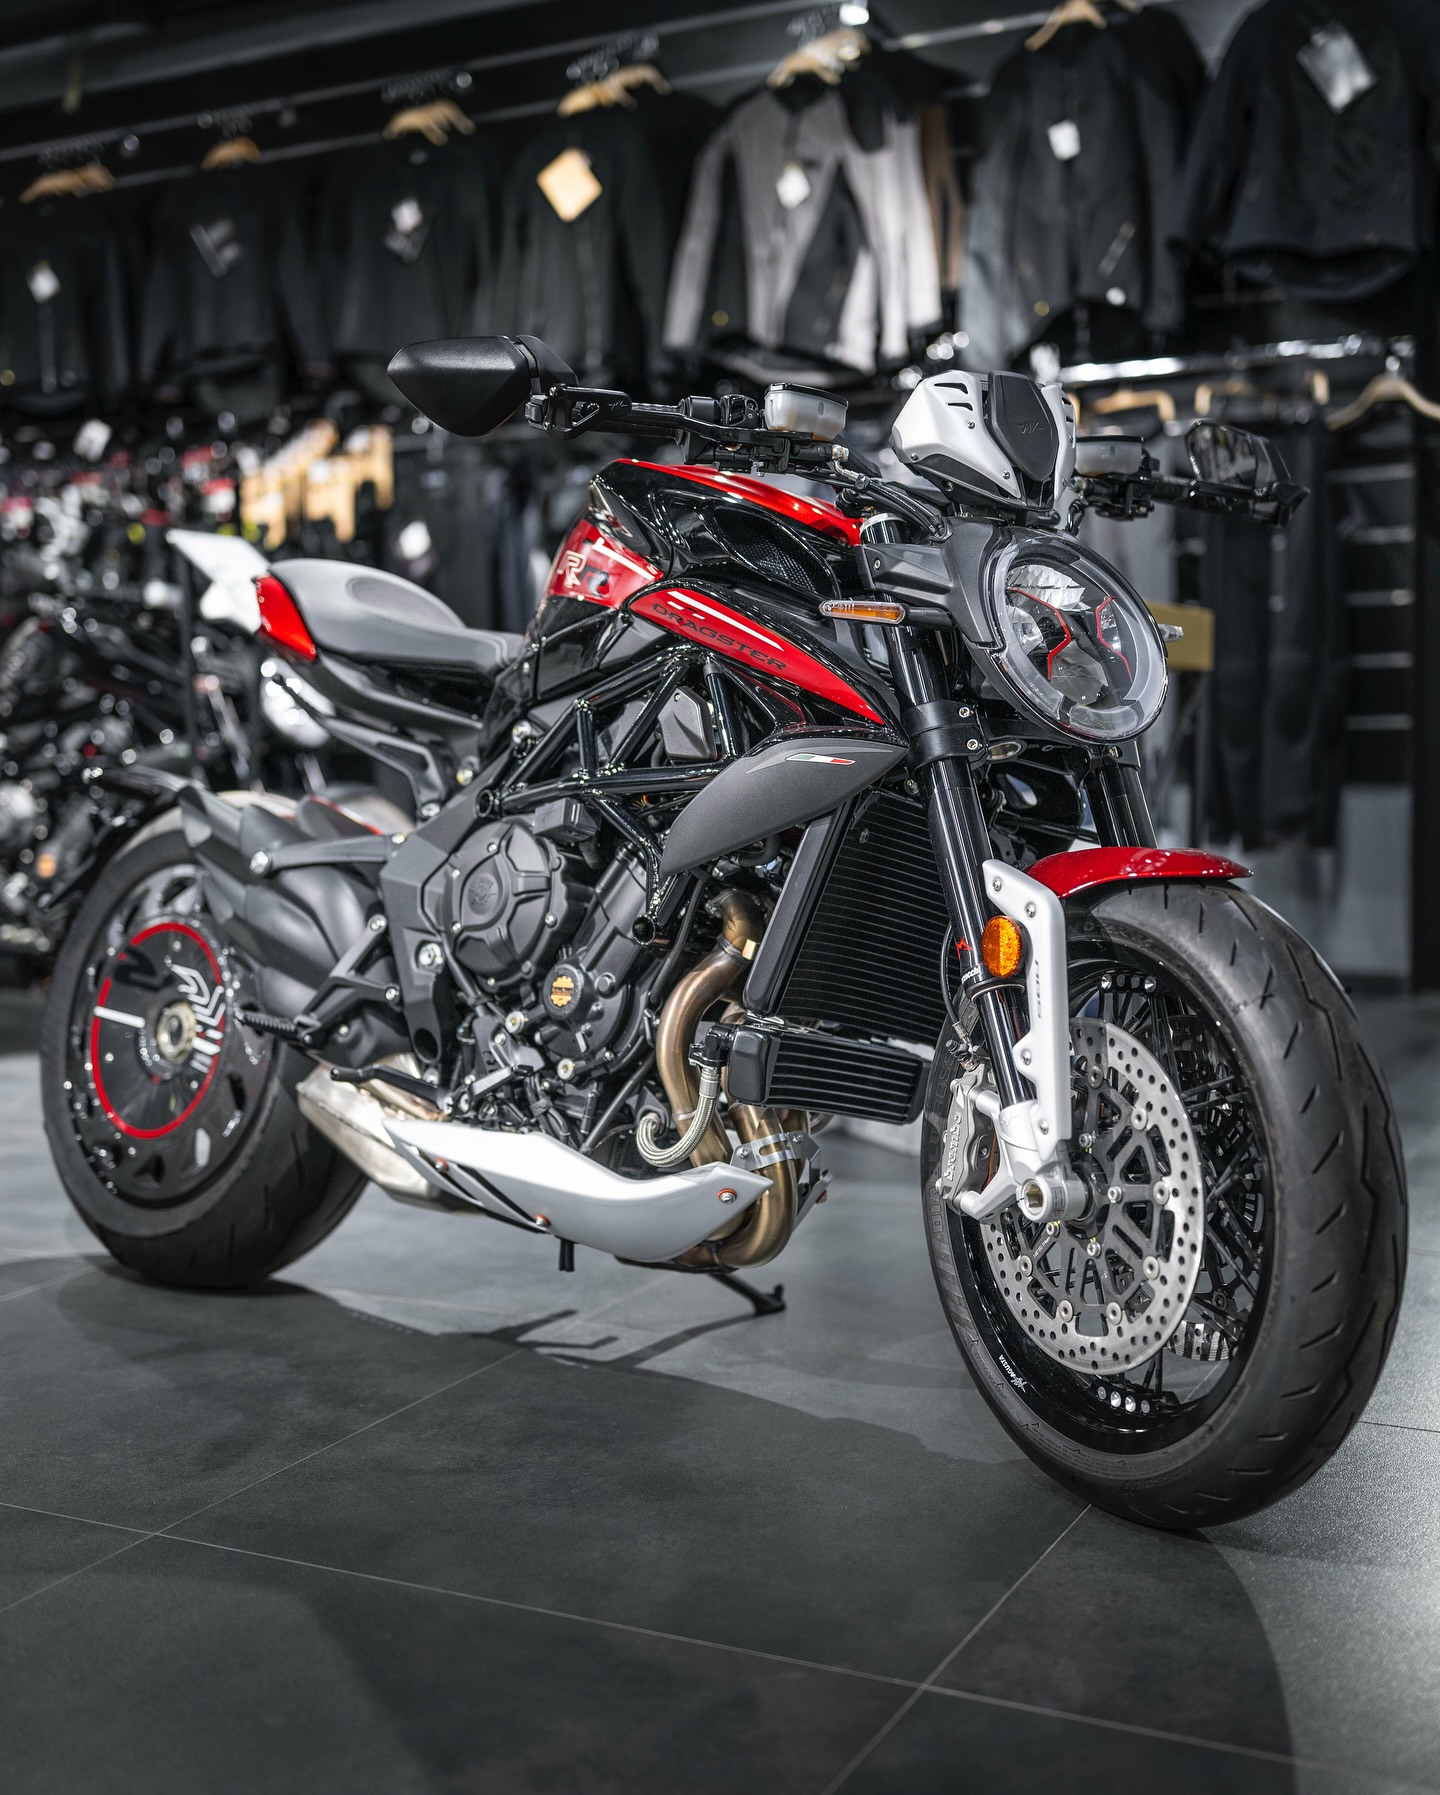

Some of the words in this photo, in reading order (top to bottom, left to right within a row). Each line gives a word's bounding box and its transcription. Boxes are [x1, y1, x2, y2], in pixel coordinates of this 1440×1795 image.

[651, 602, 787, 671] DRAGSTER
[943, 1111, 963, 1182] brembo
[998, 1354, 1017, 1378] AGUSTA
